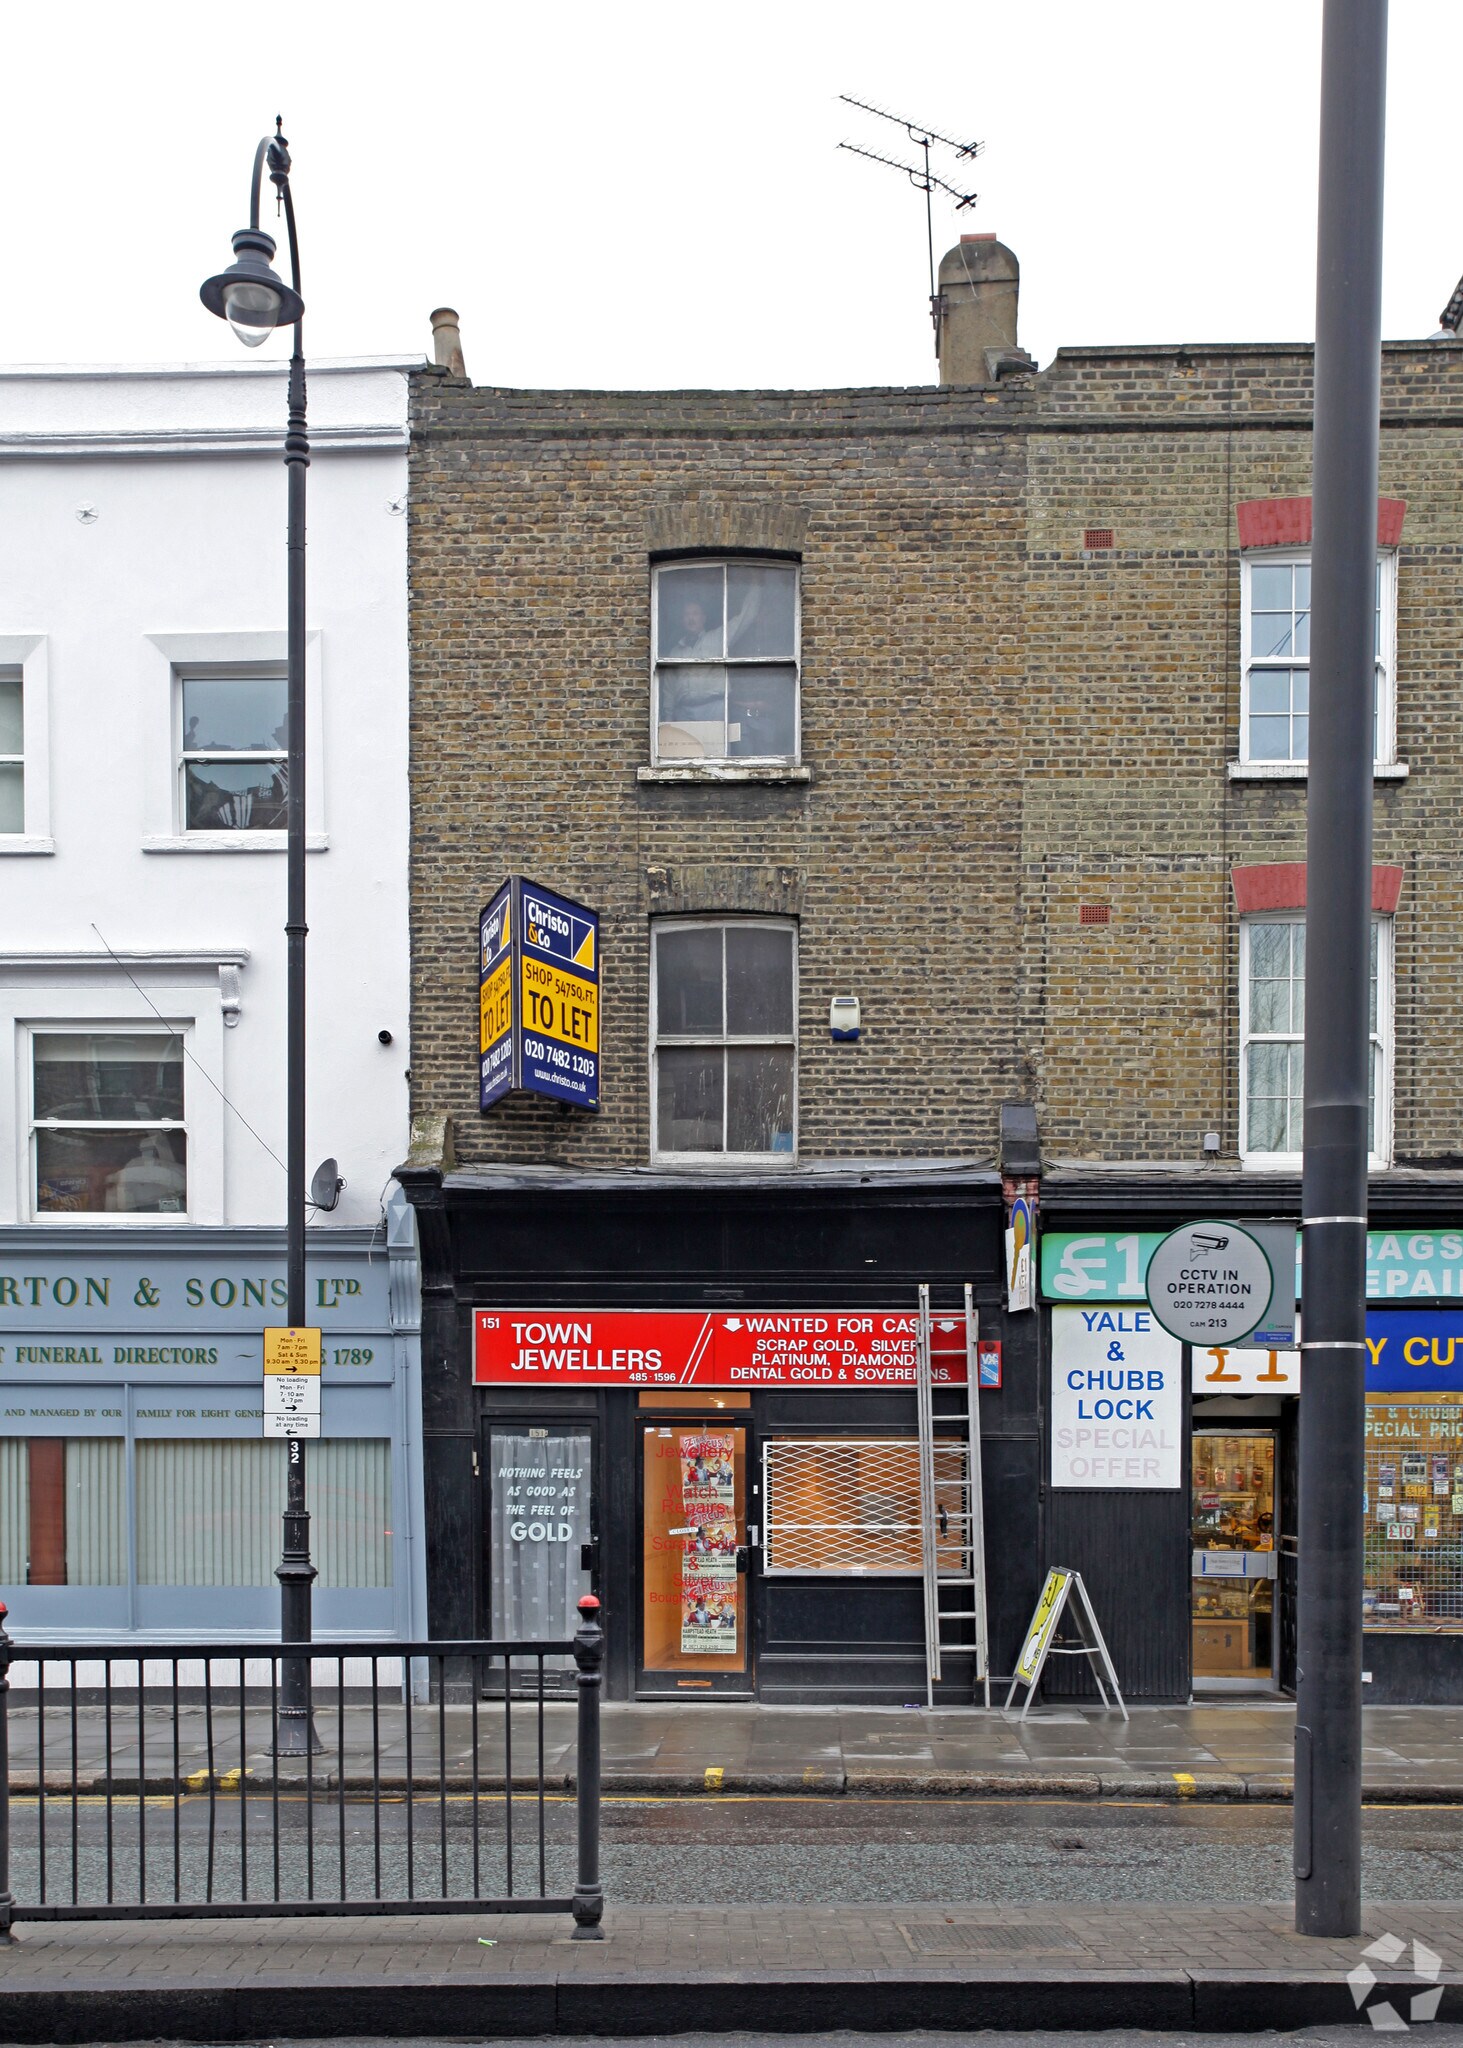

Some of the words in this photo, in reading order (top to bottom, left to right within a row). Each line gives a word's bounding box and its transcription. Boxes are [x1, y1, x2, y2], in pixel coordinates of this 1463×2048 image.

[528, 902, 569, 937] Christo
[483, 917, 499, 946] Christo
[525, 963, 552, 987] SHOP
[482, 981, 493, 1005] SHOP
[483, 1008, 493, 1045] TO
[496, 989, 510, 1033] LET
[528, 990, 553, 1030] TO
[561, 1002, 592, 1043] LET
[525, 1038, 544, 1059] 020
[546, 1045, 570, 1069] 7482
[572, 1055, 594, 1077] 1203
[534, 1067, 586, 1093] www.christo.co.uk
[1053, 1236, 1147, 1297] £1
[1180, 1269, 1218, 1280] CCTV
[1223, 1269, 1238, 1280] IN
[1167, 1283, 1251, 1294] OPERATION
[1366, 1269, 1463, 1295] EPAI
[133, 1277, 161, 1308] &
[186, 1277, 289, 1308] SONS
[1173, 1301, 1193, 1309] 020
[1194, 1301, 1217, 1309] 7278
[1218, 1301, 1245, 1309] 4444
[481, 1317, 500, 1329] 151
[745, 1318, 828, 1333] WANTED
[837, 1318, 873, 1333] FOR
[1081, 1312, 1151, 1332] YALE
[1208, 1319, 1227, 1328] 213
[511, 1323, 592, 1344] TOWN
[756, 1339, 808, 1352] SCRAP
[1107, 1341, 1125, 1361] &
[15, 1346, 103, 1364] FUNERAL
[113, 1346, 218, 1365] DIRECTORS
[333, 1348, 374, 1365] 1789
[511, 1349, 662, 1371] JEWELLERS
[842, 1354, 918, 1366] DIAMOND
[730, 1367, 786, 1380] DENTAL
[790, 1367, 833, 1380] GOLD
[838, 1367, 847, 1380] &
[854, 1367, 951, 1381] SOVEREINS.
[1067, 1369, 1164, 1391] CHUBB
[4, 1409, 26, 1417] AND
[30, 1409, 80, 1417] MANAGED
[84, 1409, 96, 1417] BY
[101, 1409, 122, 1417] OUR
[136, 1409, 172, 1418] FAMILY
[176, 1409, 197, 1418] FOR
[201, 1409, 231, 1418] EIGHT
[1078, 1399, 1154, 1420] LOCK
[1056, 1428, 1175, 1449] SPECIAL
[656, 1443, 734, 1461] Jewellery
[498, 1468, 546, 1478] NOTHING
[551, 1468, 583, 1479] FEELS
[1069, 1457, 1160, 1478] OFFER
[507, 1486, 521, 1496] AS
[526, 1486, 556, 1496] GOOD
[561, 1486, 576, 1497] AS
[666, 1484, 719, 1499] Watch
[505, 1504, 525, 1515] THE
[530, 1505, 555, 1516] FEEL
[560, 1505, 575, 1516] OF
[662, 1498, 725, 1517] Repairs
[510, 1521, 573, 1542] GOLD
[1388, 1523, 1413, 1538] £10
[652, 1536, 697, 1553] Scrap
[703, 1535, 738, 1551] Gold
[688, 1556, 699, 1571] &
